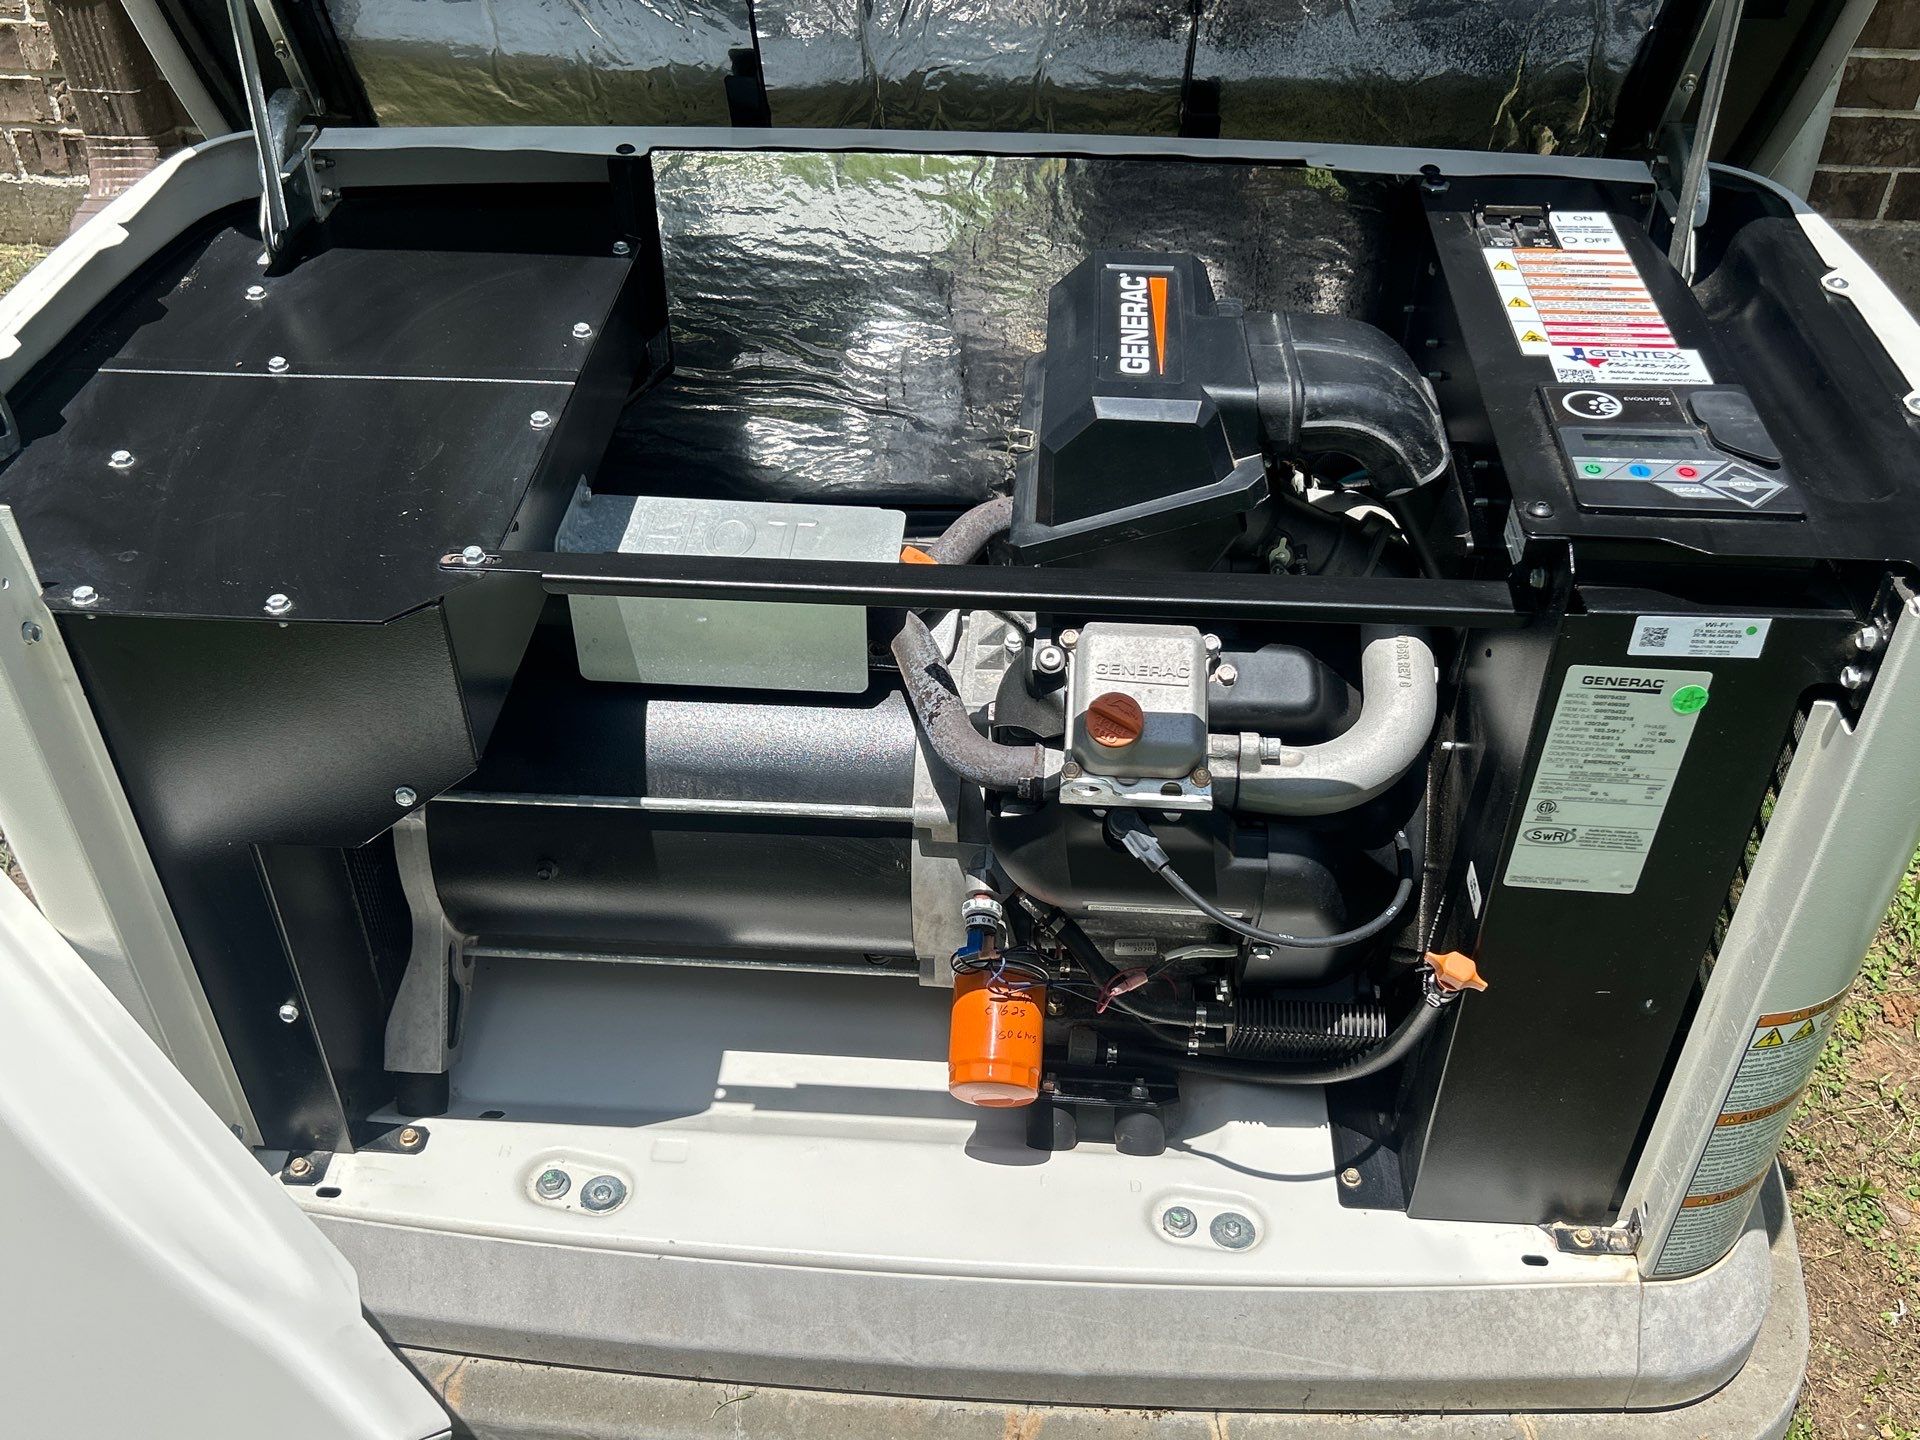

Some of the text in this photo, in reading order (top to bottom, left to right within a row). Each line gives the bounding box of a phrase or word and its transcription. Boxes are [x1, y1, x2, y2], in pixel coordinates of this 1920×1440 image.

[1120, 274, 1151, 375] GENERAC
[1589, 349, 1685, 360] GENTEX
[1096, 663, 1190, 679] GENERAC
[1582, 676, 1665, 688] GENERAC
[1531, 831, 1568, 842] SwRI
